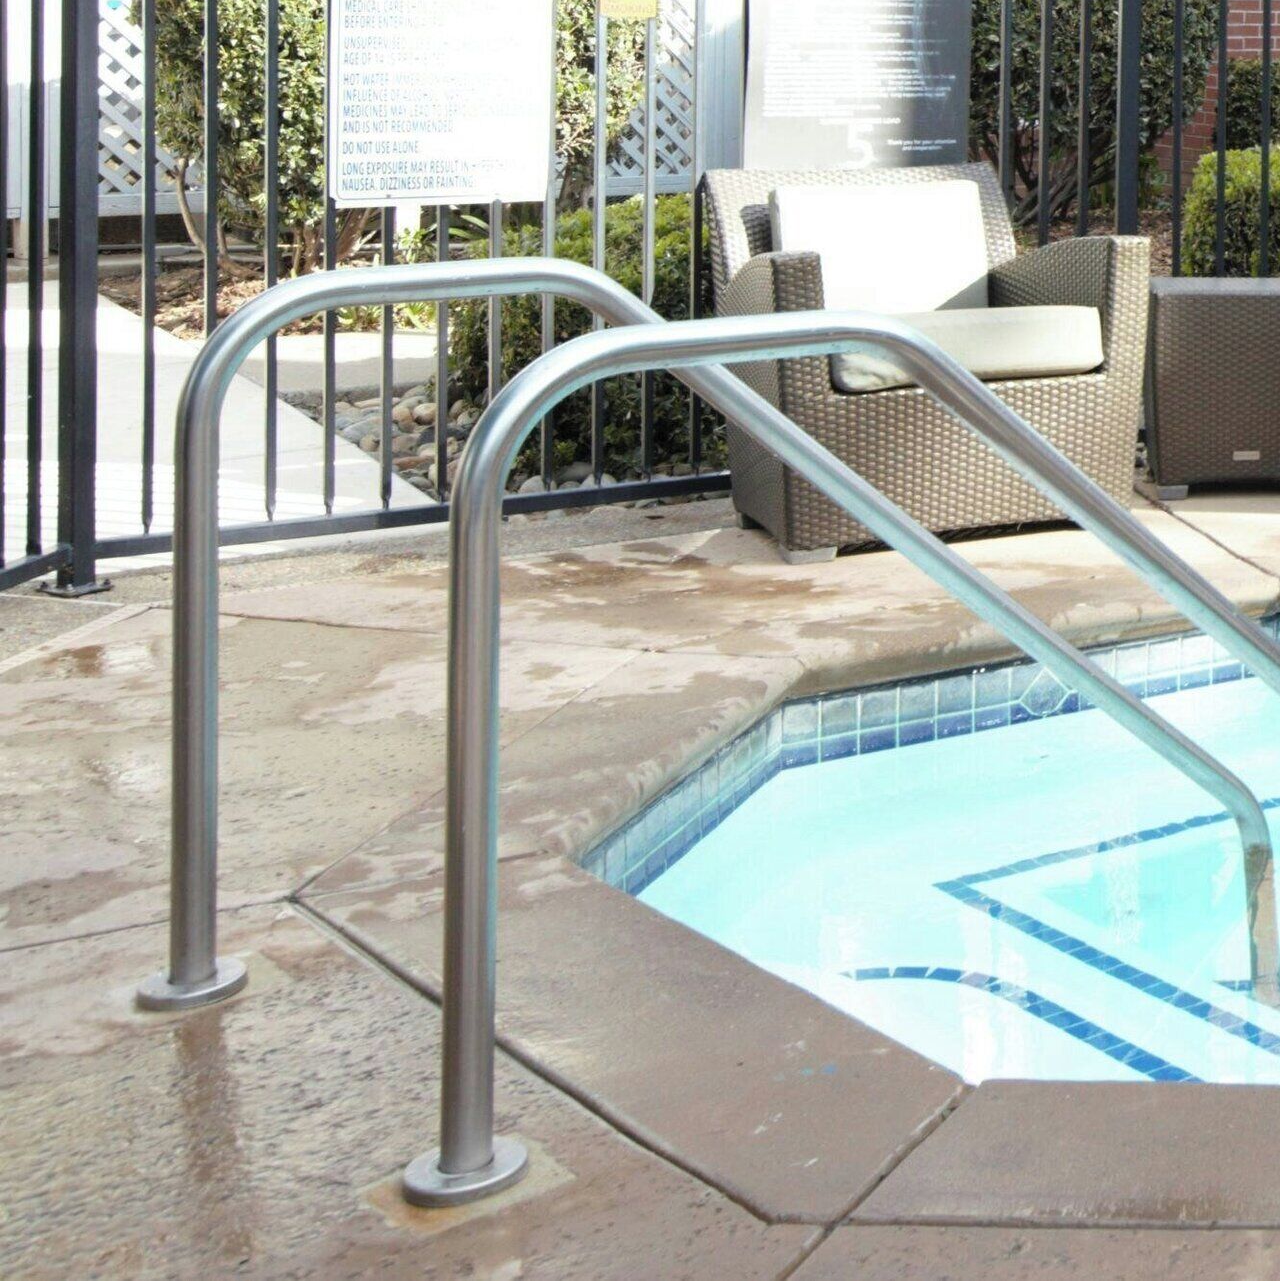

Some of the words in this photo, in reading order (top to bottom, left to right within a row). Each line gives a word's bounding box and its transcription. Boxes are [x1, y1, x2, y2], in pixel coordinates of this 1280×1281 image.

[344, 0, 381, 13] MEDICAL
[344, 15, 375, 28] BEFORE
[343, 53, 361, 66] AGE
[361, 53, 373, 66] OF
[342, 73, 361, 86] HOT
[362, 73, 390, 86] WATER
[342, 89, 388, 102] INFLUENCE
[342, 104, 388, 118] MEDICINES
[390, 104, 407, 118] MAY
[342, 121, 361, 134] AND
[361, 121, 370, 134] IS
[372, 121, 389, 134] NOT
[342, 141, 355, 154] DO
[356, 141, 374, 154] NOT
[375, 141, 391, 154] USE
[847, 124, 876, 168] 5
[342, 161, 365, 176] LONG
[366, 161, 408, 175] EXPOSURE
[410, 160, 429, 174] MAY
[430, 160, 460, 174] RESULT
[379, 177, 422, 191] DIZZINESS
[422, 177, 434, 190] OR
